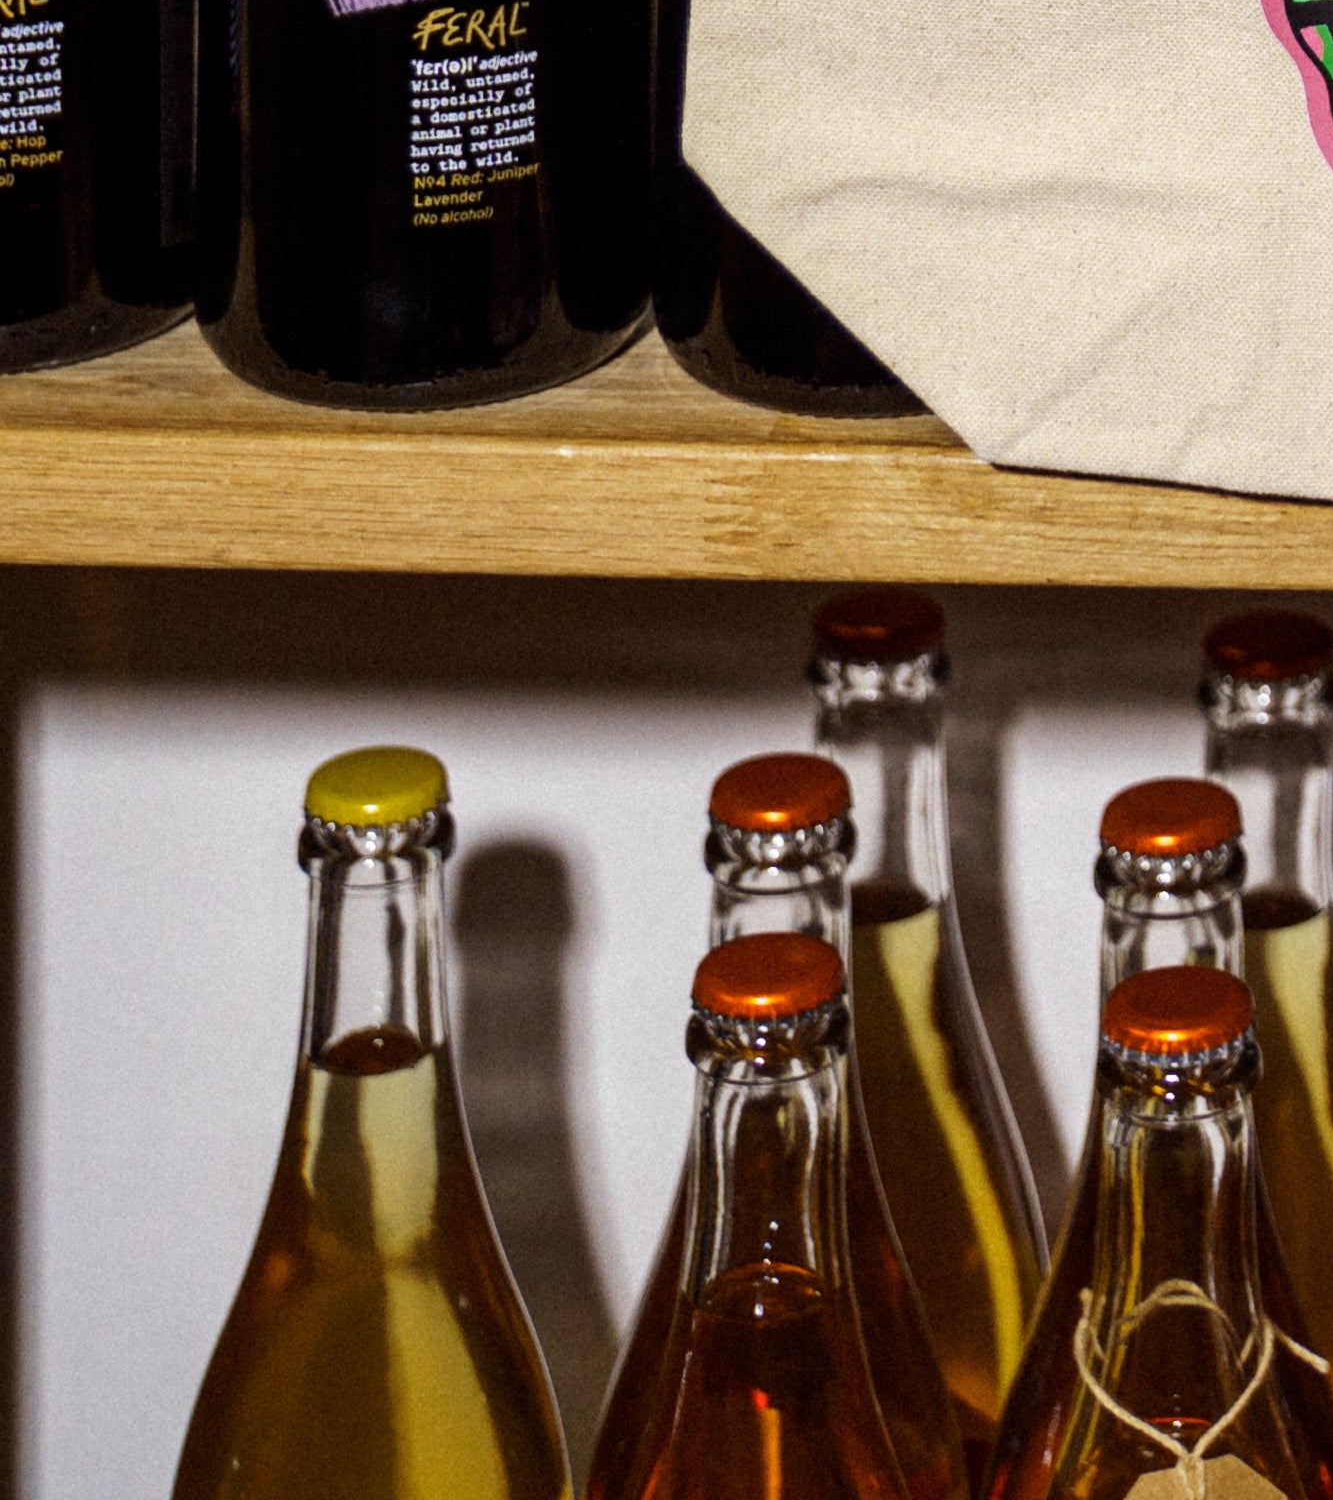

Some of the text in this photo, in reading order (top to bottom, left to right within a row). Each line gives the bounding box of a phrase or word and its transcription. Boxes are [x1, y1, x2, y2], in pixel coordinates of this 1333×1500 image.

[1, 20, 65, 39] adjective
[0, 38, 62, 55] ntamed,
[39, 53, 60, 67] of
[478, 50, 538, 72] adjective
[0, 68, 62, 86] ticated
[411, 68, 536, 93] Wild, untamed,
[19, 85, 62, 104] plant
[412, 82, 534, 111] especially of
[0, 100, 62, 118] eturned
[412, 97, 536, 125] a domesticated
[411, 114, 536, 141] animal or plant
[16, 135, 46, 150] Hop
[410, 130, 536, 160] having returned
[11, 150, 64, 169] Pepper
[411, 151, 520, 174] to the wild.
[487, 162, 541, 182] Juniper
[414, 190, 485, 208] Lavender
[413, 206, 495, 227] (No alcohol)
